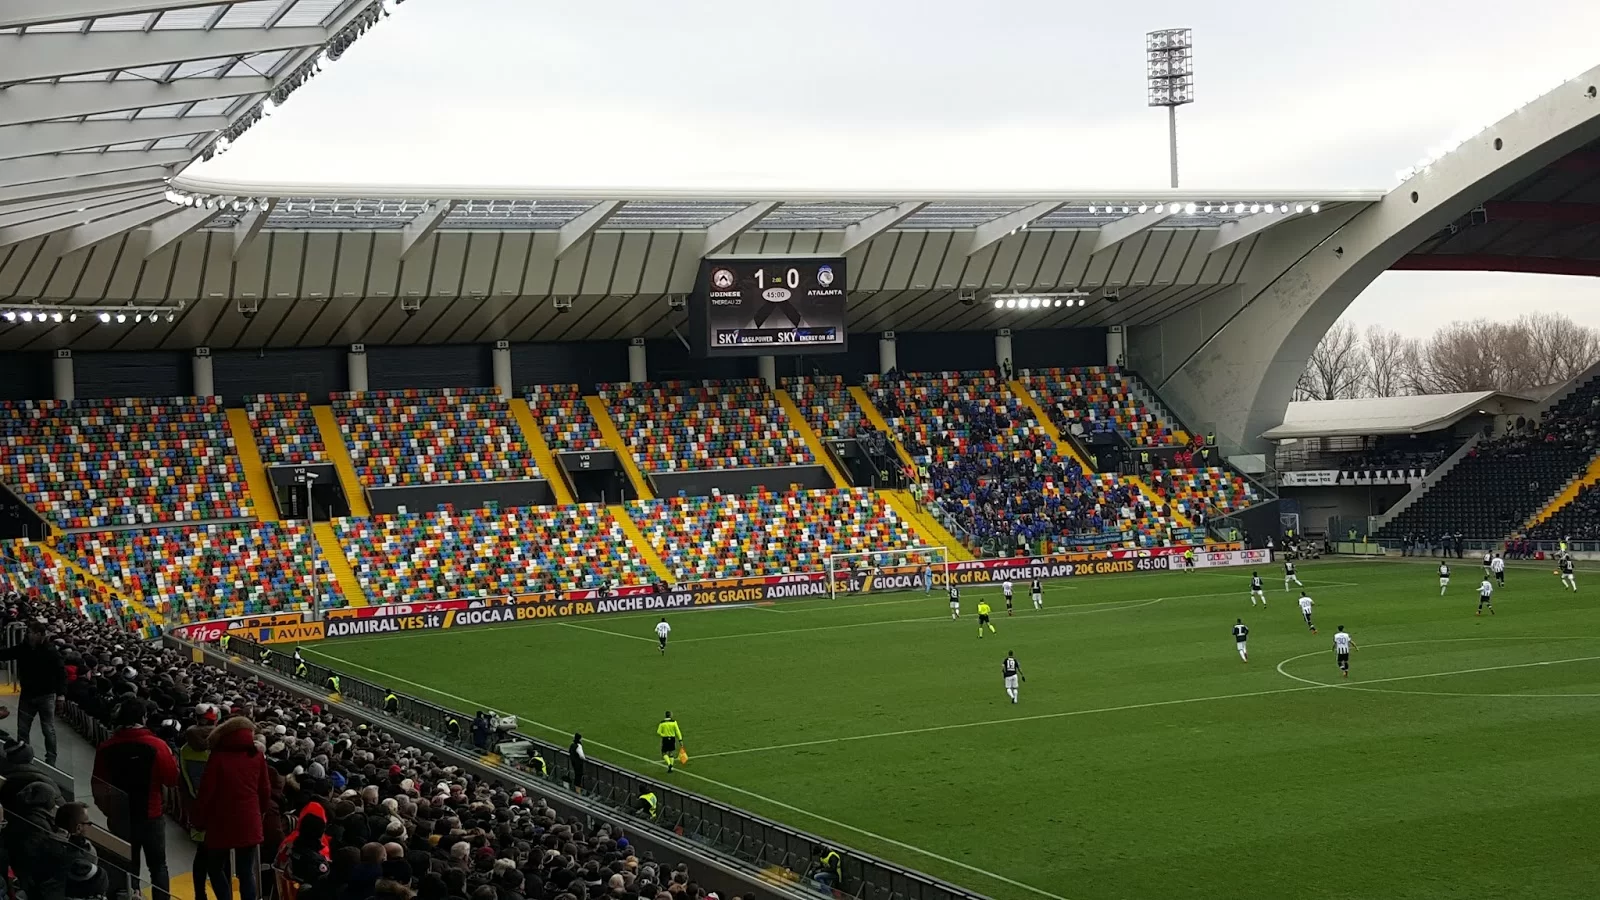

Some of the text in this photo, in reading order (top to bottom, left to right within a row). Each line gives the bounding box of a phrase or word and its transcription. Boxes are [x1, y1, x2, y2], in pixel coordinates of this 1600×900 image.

[754, 268, 764, 289] 1
[786, 268, 800, 289] 0
[719, 332, 738, 344] SKY
[778, 331, 797, 343] SKY
[1207, 553, 1232, 561] PLAY
[1240, 551, 1266, 559] PLAY
[767, 580, 860, 599] ADMIRALYES.it
[874, 575, 911, 589] GIOCA
[913, 575, 922, 587] A
[960, 570, 973, 582] of
[974, 570, 990, 582] RA
[992, 567, 1032, 582] ANCHE
[1034, 566, 1050, 578] DA
[1051, 565, 1073, 577] APP
[1075, 563, 1094, 575] 20€
[1095, 561, 1134, 574] GRATIS
[1137, 557, 1167, 570] 45:00
[327, 614, 439, 636] ADMIRALYES.it
[456, 610, 500, 625] GIOCA
[503, 609, 514, 621] A
[516, 605, 557, 620] BOOK
[560, 603, 573, 616] of
[575, 602, 595, 615] RA
[597, 597, 643, 613] ANCHE
[645, 595, 665, 608] DA
[667, 594, 692, 607] APP
[694, 592, 717, 605] 20€
[718, 588, 763, 602] GRATIS
[278, 627, 321, 639] AVIVA
[1006, 660, 1015, 668] 19
